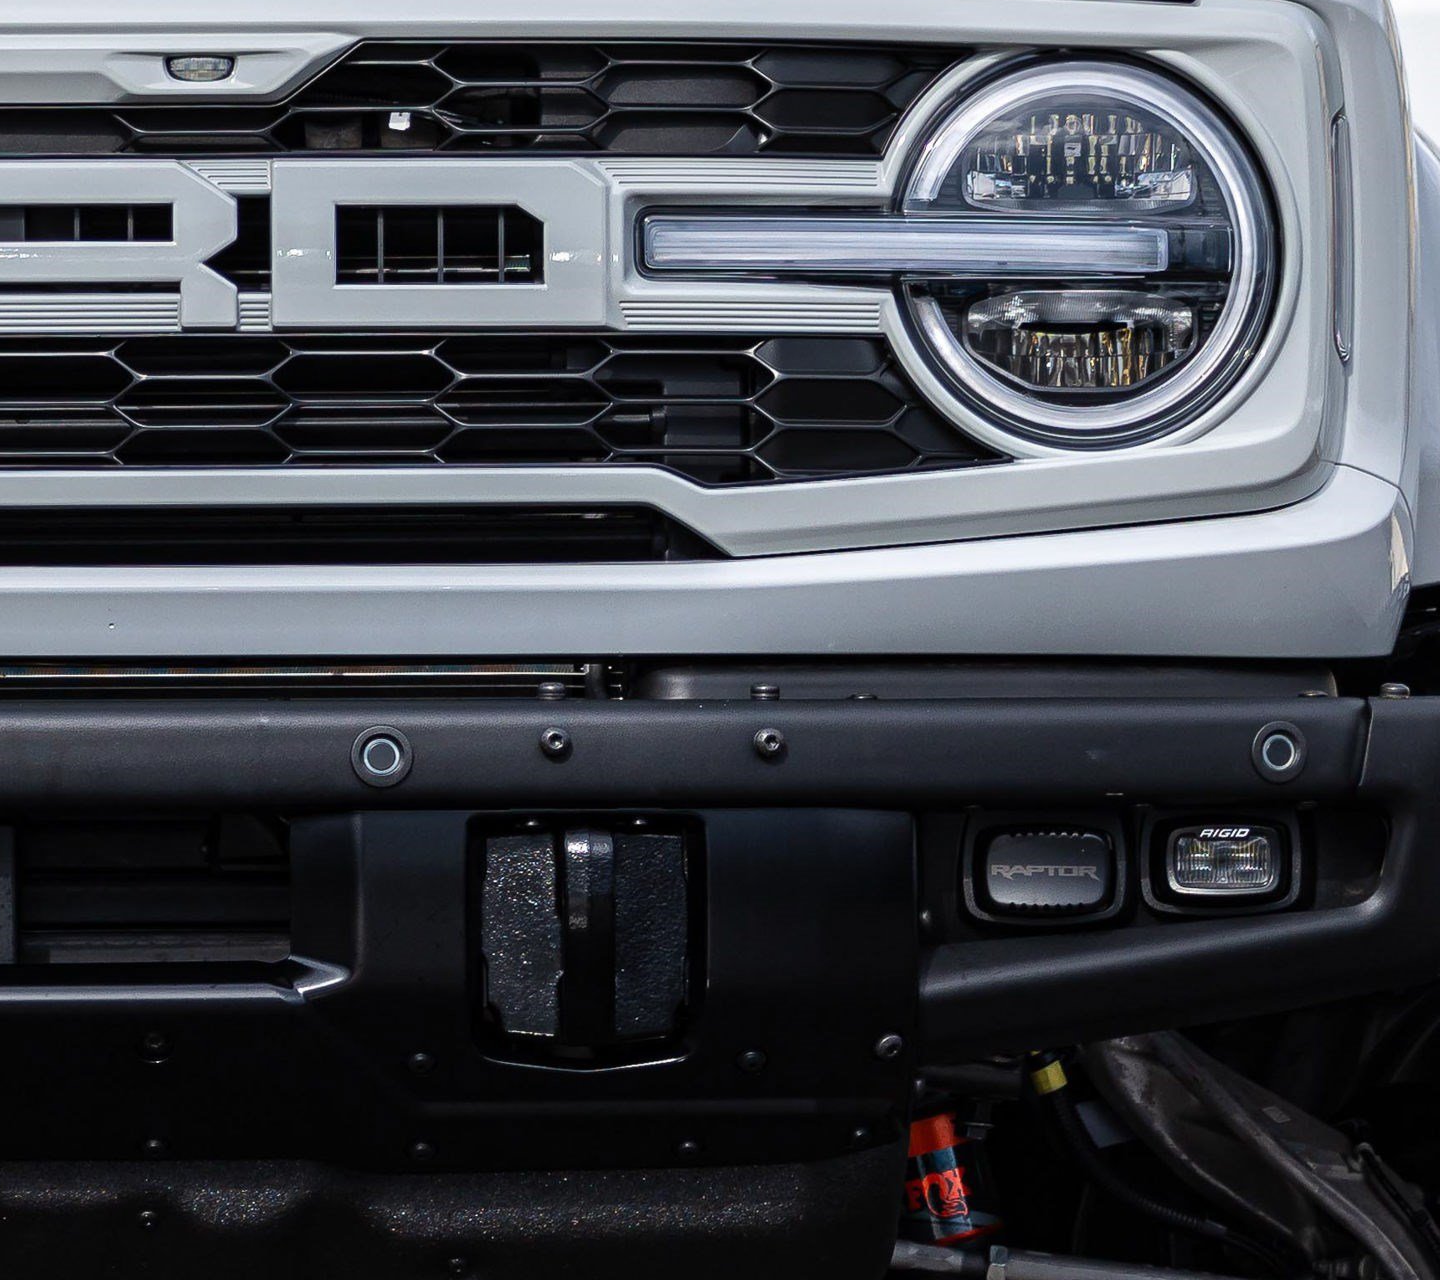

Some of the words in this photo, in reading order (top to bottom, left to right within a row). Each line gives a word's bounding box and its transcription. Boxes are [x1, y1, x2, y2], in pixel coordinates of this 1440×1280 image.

[1199, 828, 1250, 839] RIGID
[991, 865, 1101, 882] RAPTOR
[905, 1167, 971, 1217] FOX
